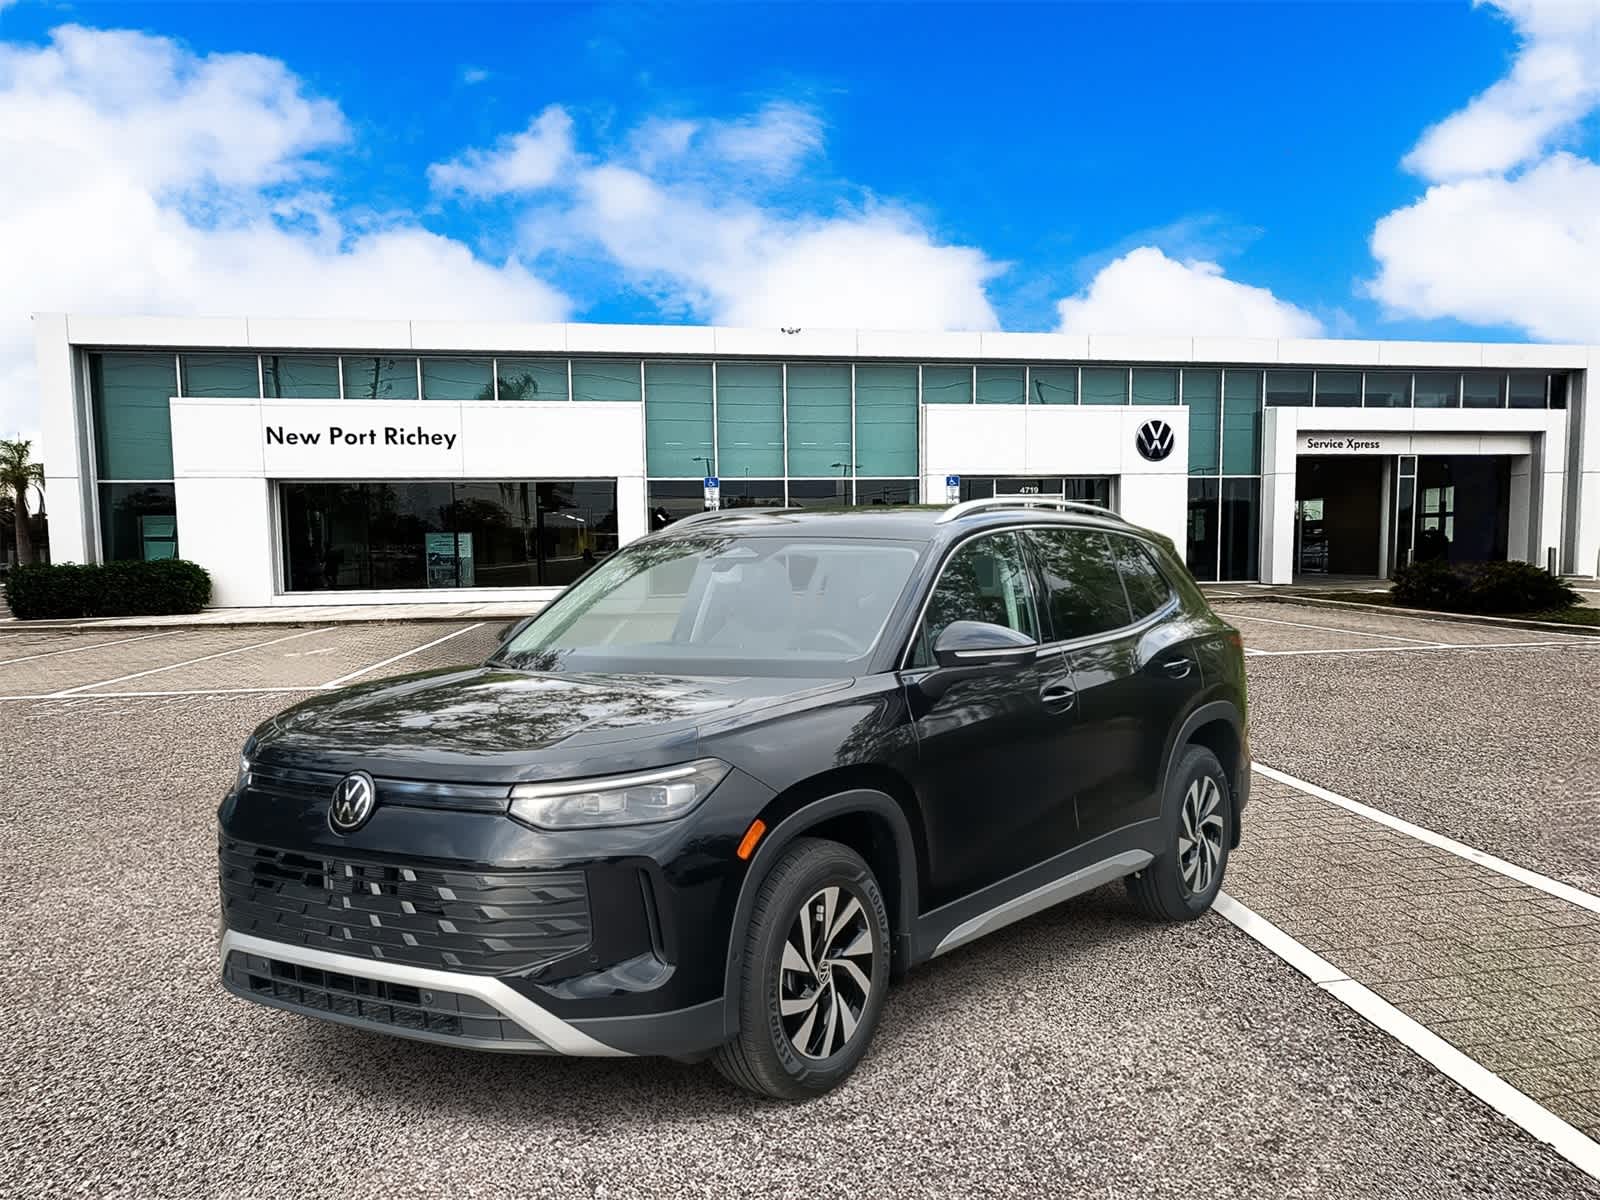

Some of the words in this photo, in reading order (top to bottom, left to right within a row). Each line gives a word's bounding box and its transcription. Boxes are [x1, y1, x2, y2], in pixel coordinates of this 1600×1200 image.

[266, 427, 320, 445] New
[330, 427, 376, 446] Port
[385, 427, 456, 450] Richey
[1307, 438, 1344, 449] Service
[1346, 438, 1380, 452] Xpress
[1019, 486, 1038, 494] 4719
